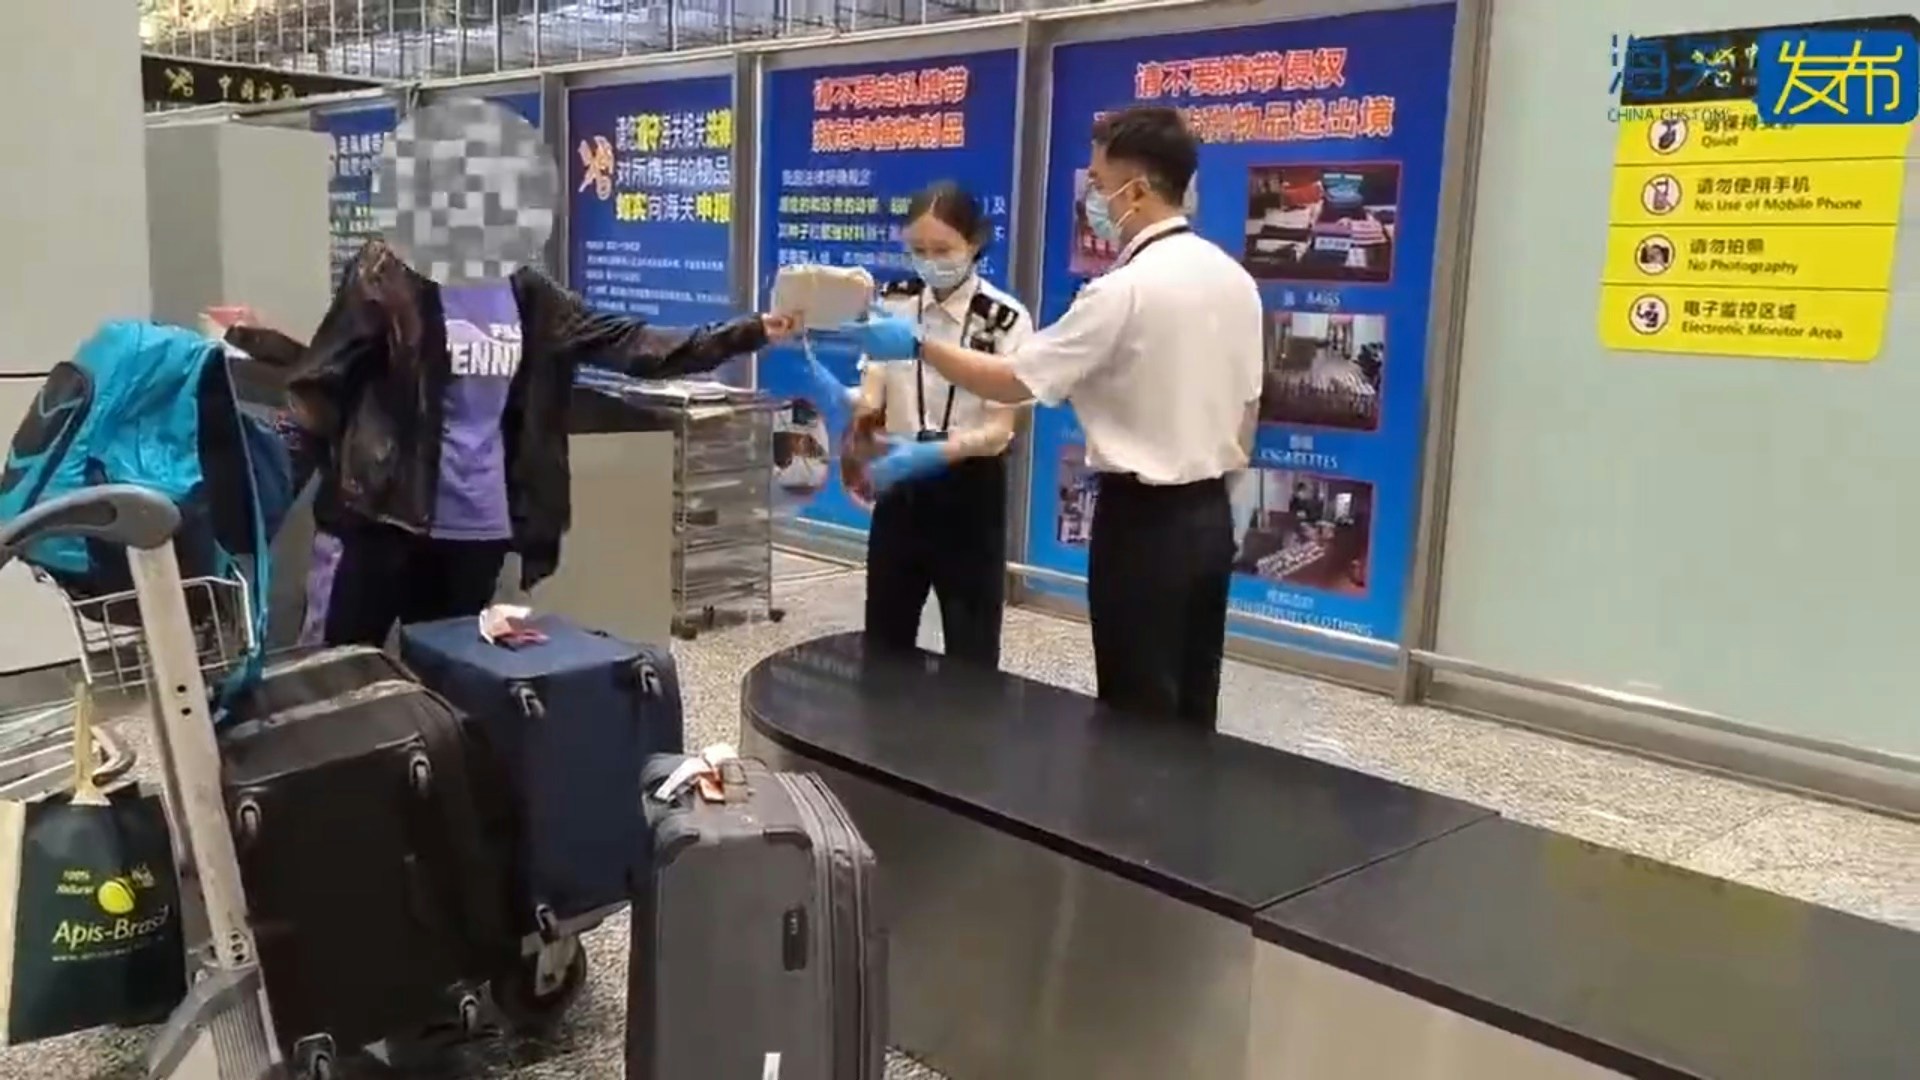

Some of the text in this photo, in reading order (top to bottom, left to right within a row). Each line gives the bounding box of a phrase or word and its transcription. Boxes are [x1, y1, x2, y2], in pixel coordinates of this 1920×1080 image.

[1135, 48, 1347, 98] 请不要携带侵权
[1701, 136, 1739, 148] Quiet
[615, 155, 731, 188] 对所携带的物品
[1697, 176, 1811, 195] 请勿使用手机
[615, 191, 731, 223] 如实向海关申报
[1694, 196, 1863, 211] No Use of Mobile Phone
[1690, 238, 1765, 255] 请勿拍照
[1687, 259, 1799, 275] No Photography
[1683, 300, 1797, 321] 电子监控区域
[1681, 320, 1844, 340] Electronic Monitor Area
